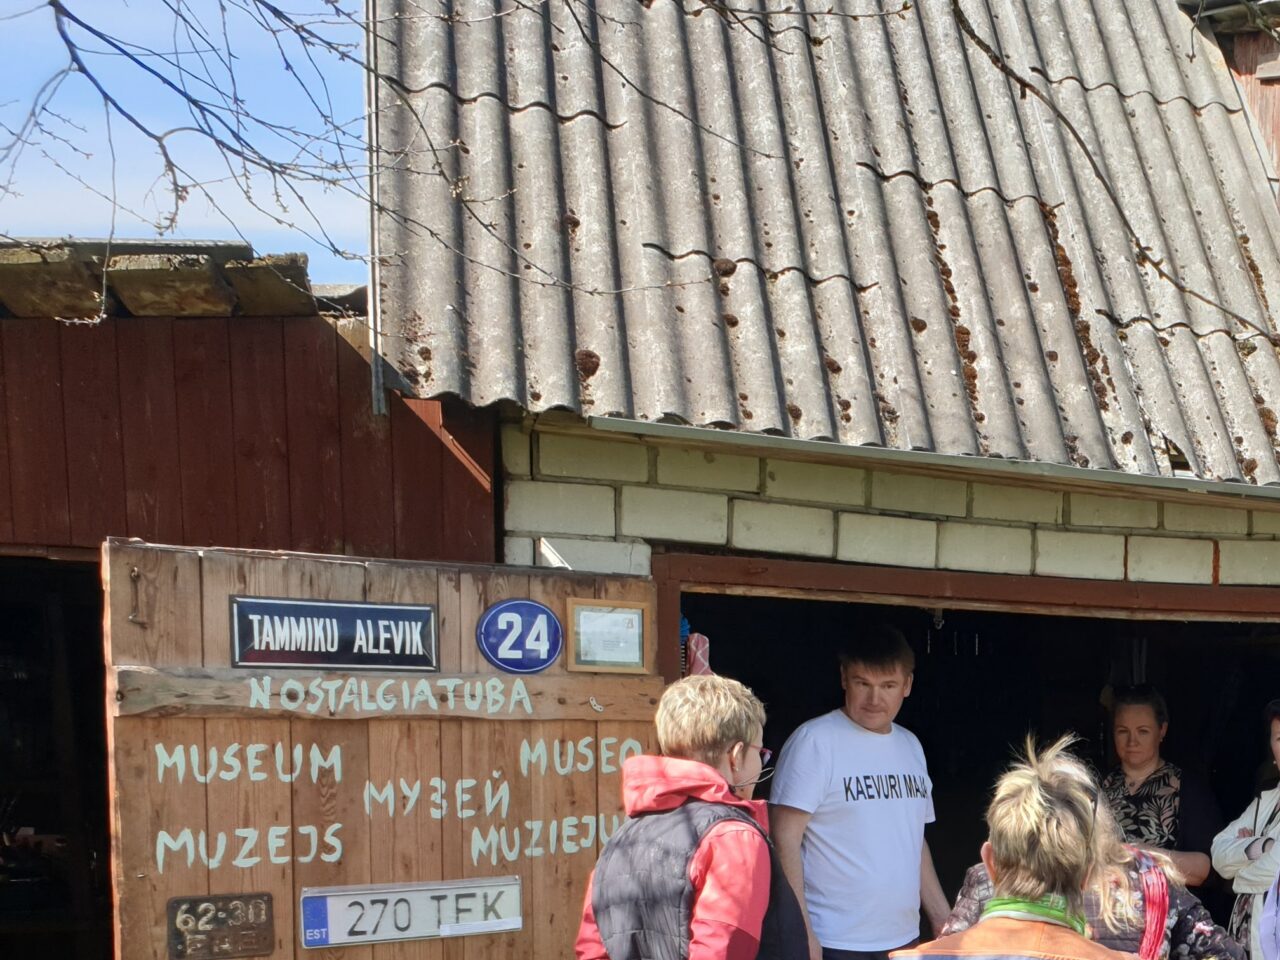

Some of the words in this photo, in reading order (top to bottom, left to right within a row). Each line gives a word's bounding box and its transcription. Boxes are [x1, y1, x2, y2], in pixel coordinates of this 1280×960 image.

[249, 614, 338, 652] TAMMIKU
[353, 619, 423, 655] ALEVIK
[497, 612, 549, 659] 24
[155, 742, 342, 784] MUSEUM
[363, 770, 510, 819] МУЗЕЙ
[843, 774, 902, 801] KAEVURI
[156, 823, 343, 874] MUZEJS
[471, 813, 629, 867] MUZIEJU
[306, 928, 328, 940] EST
[348, 898, 411, 937] 270
